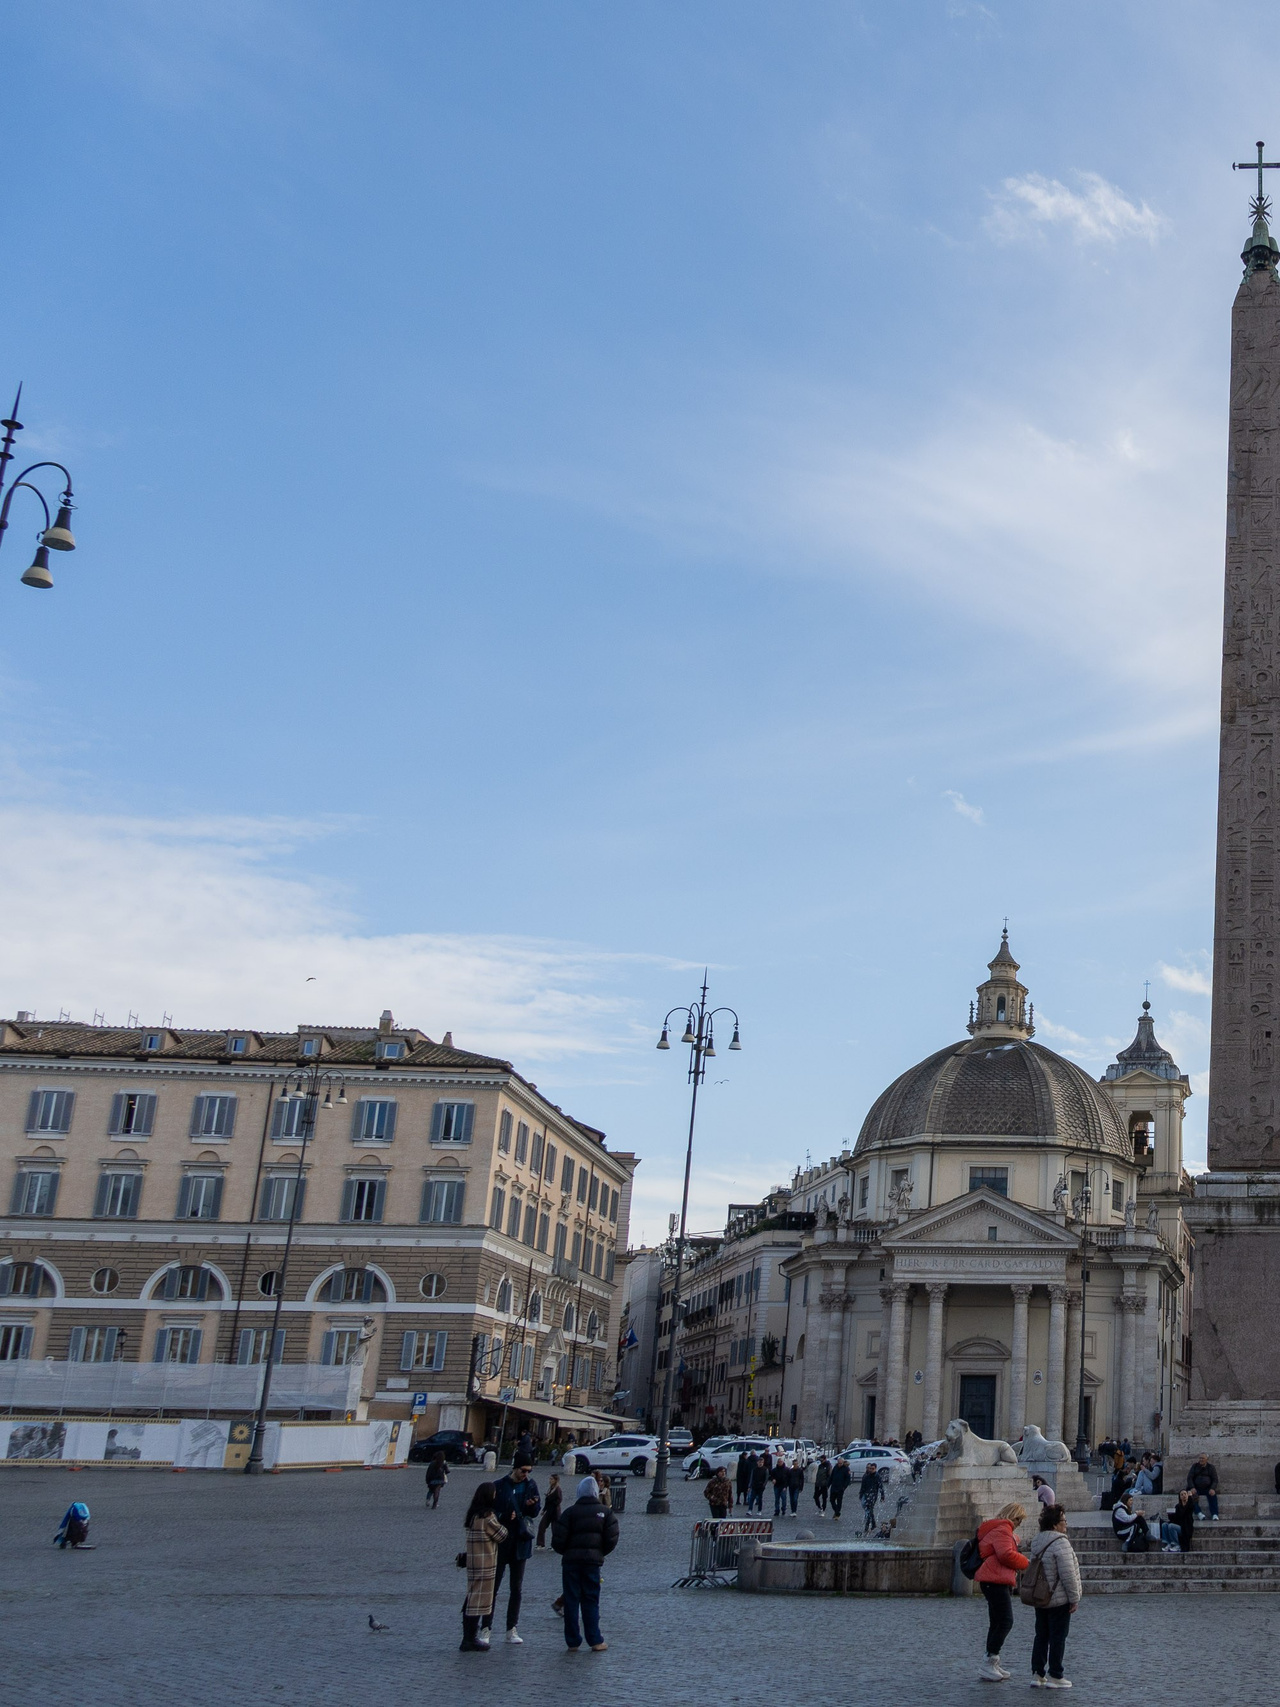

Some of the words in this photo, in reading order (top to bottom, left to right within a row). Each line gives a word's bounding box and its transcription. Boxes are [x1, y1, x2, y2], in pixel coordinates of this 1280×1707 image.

[969, 1258, 1001, 1268] CARD
[747, 1355, 757, 1408] OTTICA
[415, 1394, 425, 1405] P
